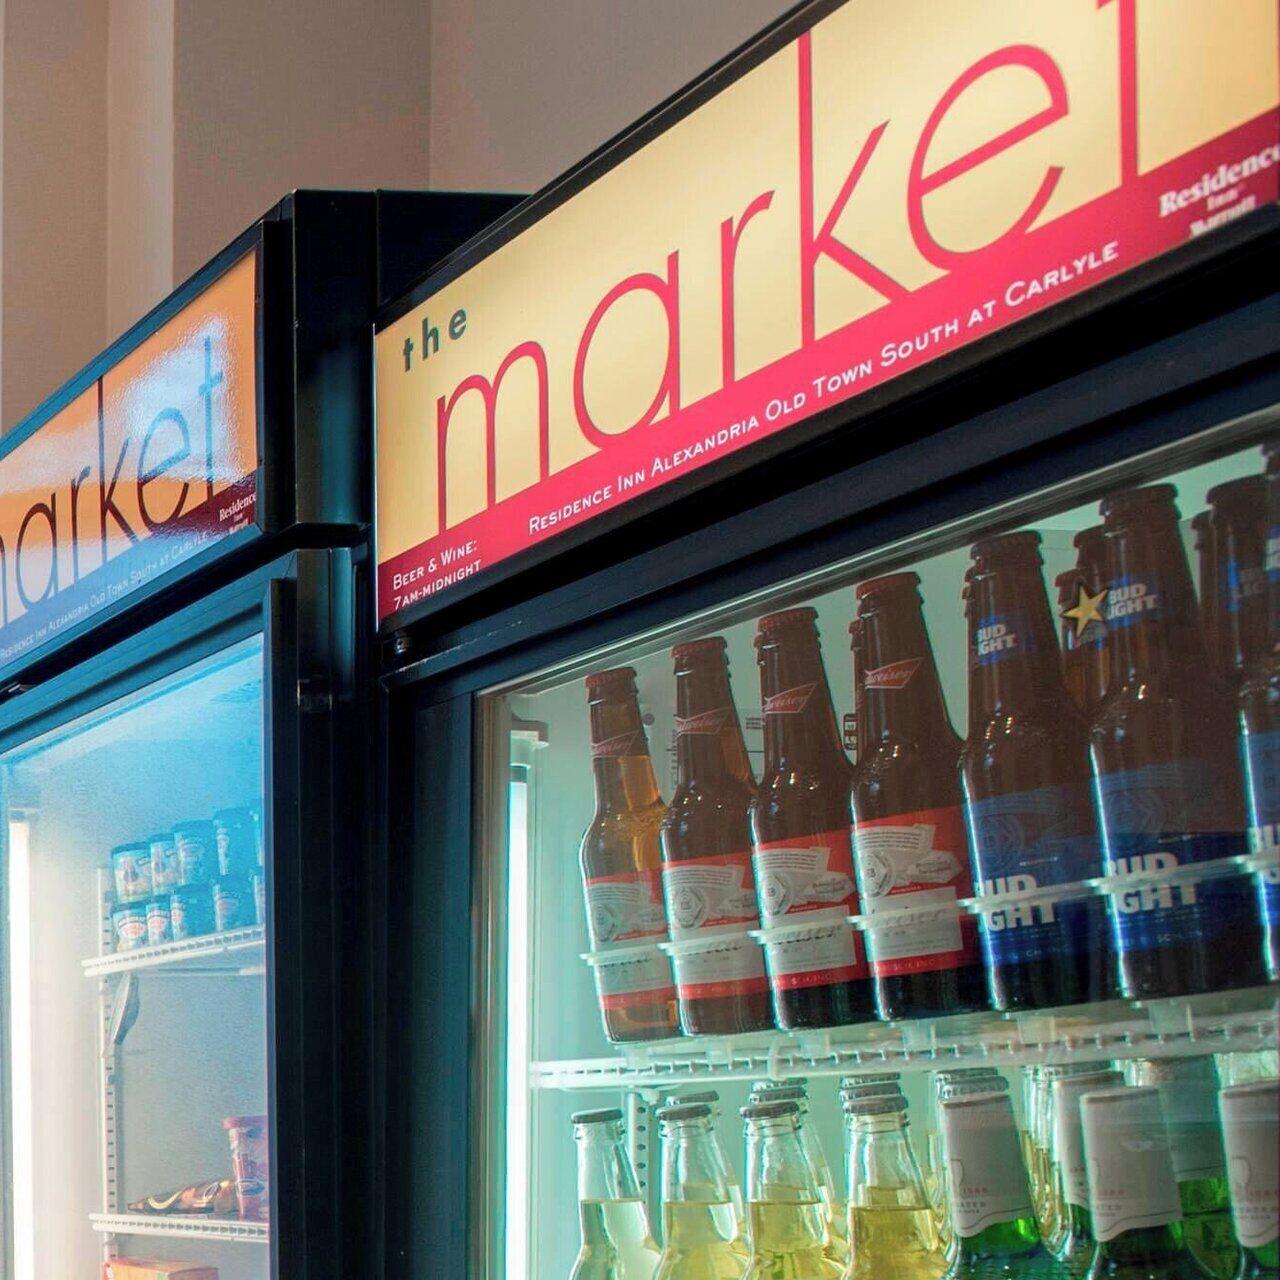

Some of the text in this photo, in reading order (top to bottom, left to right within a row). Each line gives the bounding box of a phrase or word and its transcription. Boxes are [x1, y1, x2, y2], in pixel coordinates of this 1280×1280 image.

[403, 308, 467, 373] the
[529, 485, 612, 535] RESIDENCE
[617, 468, 646, 492] INN
[651, 414, 760, 477] ALEXANDRIA
[765, 392, 807, 421] OLD
[812, 359, 873, 398] TOWN
[880, 318, 959, 369] SOUTH
[1004, 240, 1121, 308] CARLYLE
[393, 540, 478, 591] BEER & WINE:
[393, 559, 482, 611] 7AM-MIDNIGHT
[0, 631, 36, 659] RESIDENCE
[107, 579, 130, 599] TOWN
